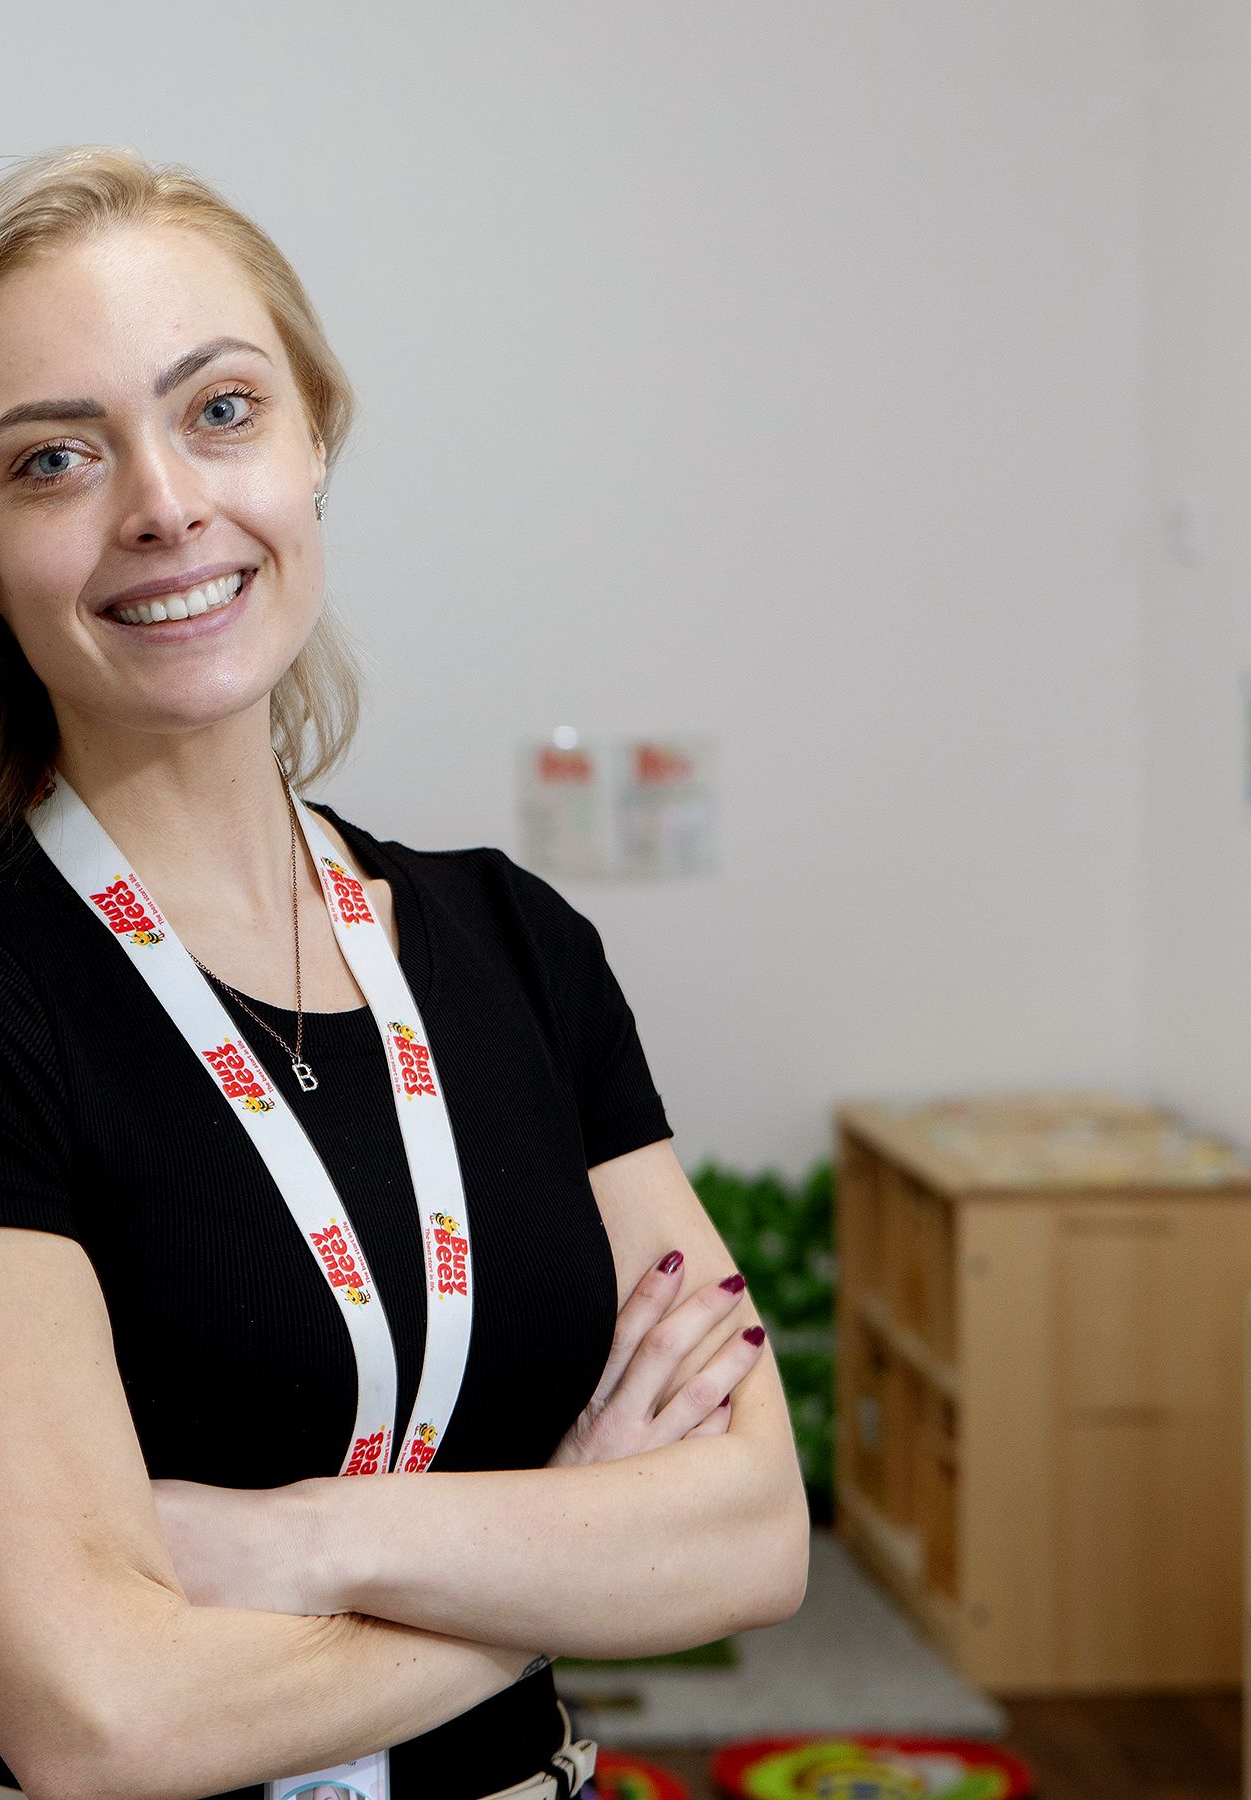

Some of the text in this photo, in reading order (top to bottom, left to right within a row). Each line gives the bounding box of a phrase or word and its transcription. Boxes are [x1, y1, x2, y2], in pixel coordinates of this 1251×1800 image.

[89, 893, 136, 934] Busy
[106, 880, 156, 932] Bees
[326, 869, 360, 925] Bees
[344, 877, 375, 924] Busy
[201, 1051, 247, 1099] Busy
[216, 1043, 266, 1098] Bees
[393, 1036, 422, 1097] Bees
[410, 1044, 437, 1097] Busy
[309, 1233, 348, 1288] Busy
[323, 1225, 364, 1289] Bees
[434, 1229, 454, 1295] Bees
[451, 1236, 468, 1296] Busy
[341, 1438, 369, 1477] usy
[359, 1431, 385, 1475] ees
[405, 1440, 424, 1473] Be
[416, 1446, 436, 1473] Bu
